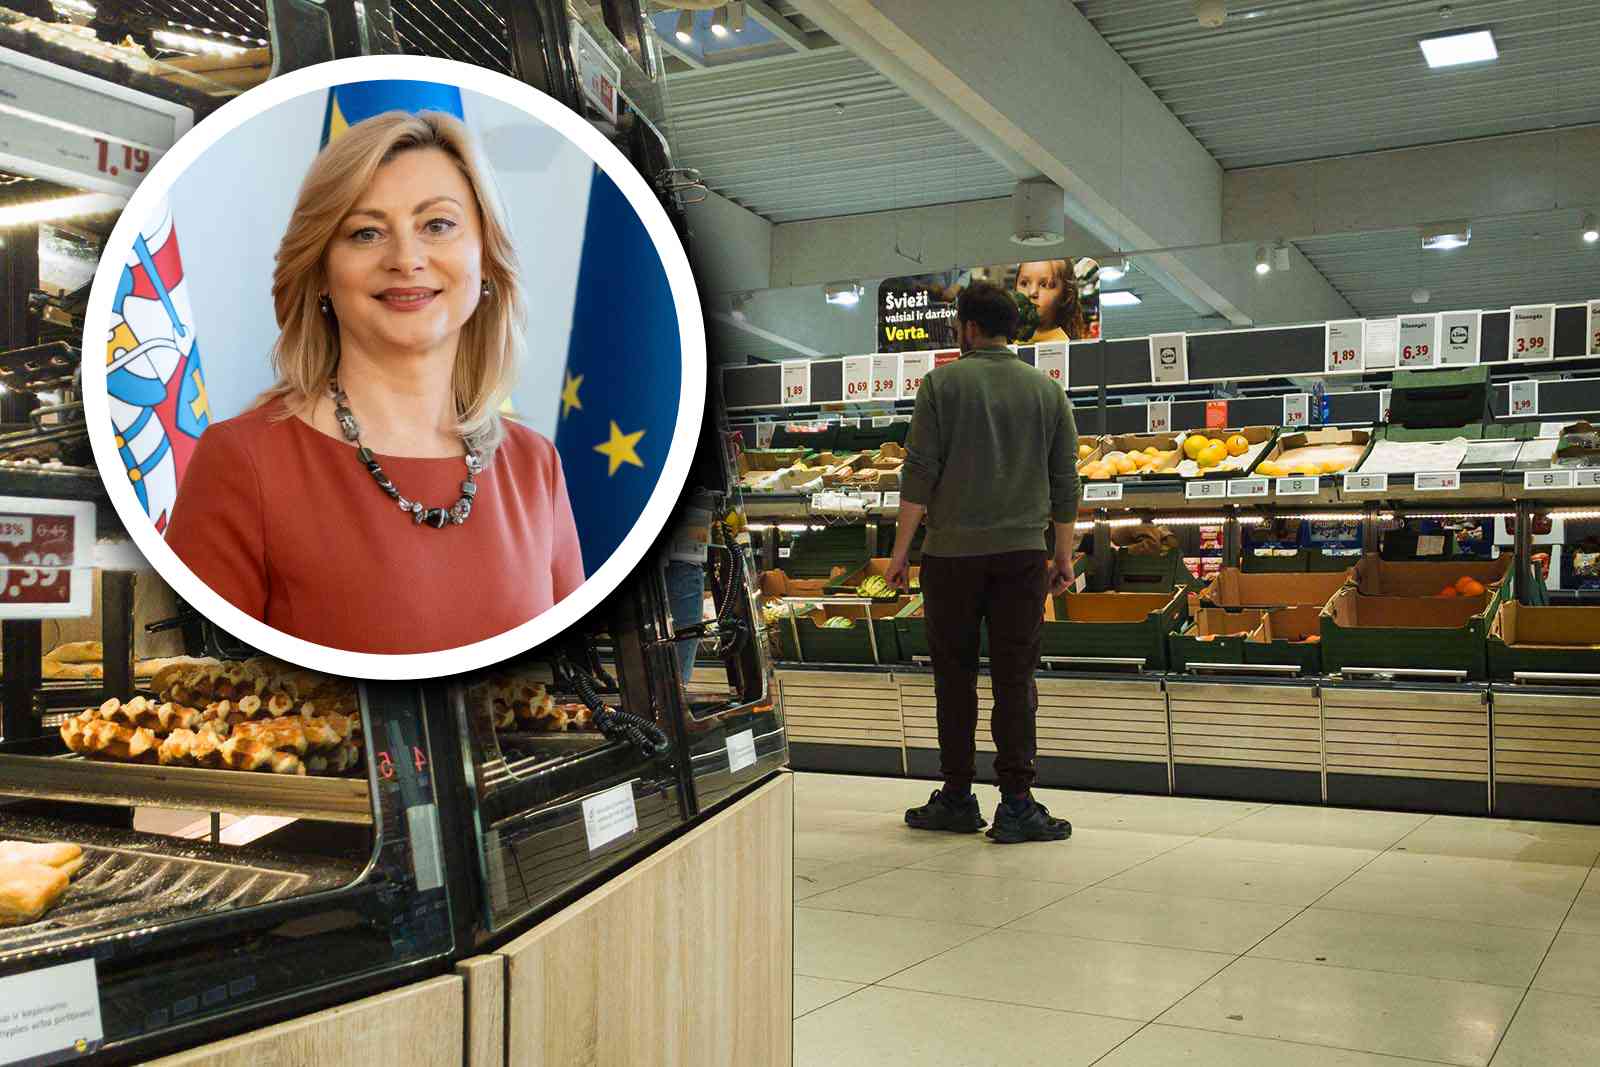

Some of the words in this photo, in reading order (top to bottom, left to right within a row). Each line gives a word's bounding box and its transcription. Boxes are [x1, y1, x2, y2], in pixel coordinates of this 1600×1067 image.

[94, 137, 149, 176] 1.19
[885, 290, 928, 310] Švieži
[925, 309, 958, 319] daržov
[885, 326, 928, 341] Verta.
[1402, 344, 1429, 361] 6.39
[1516, 336, 1544, 353] 3.99
[1332, 350, 1355, 365] 1.89
[874, 379, 894, 393] 3.99
